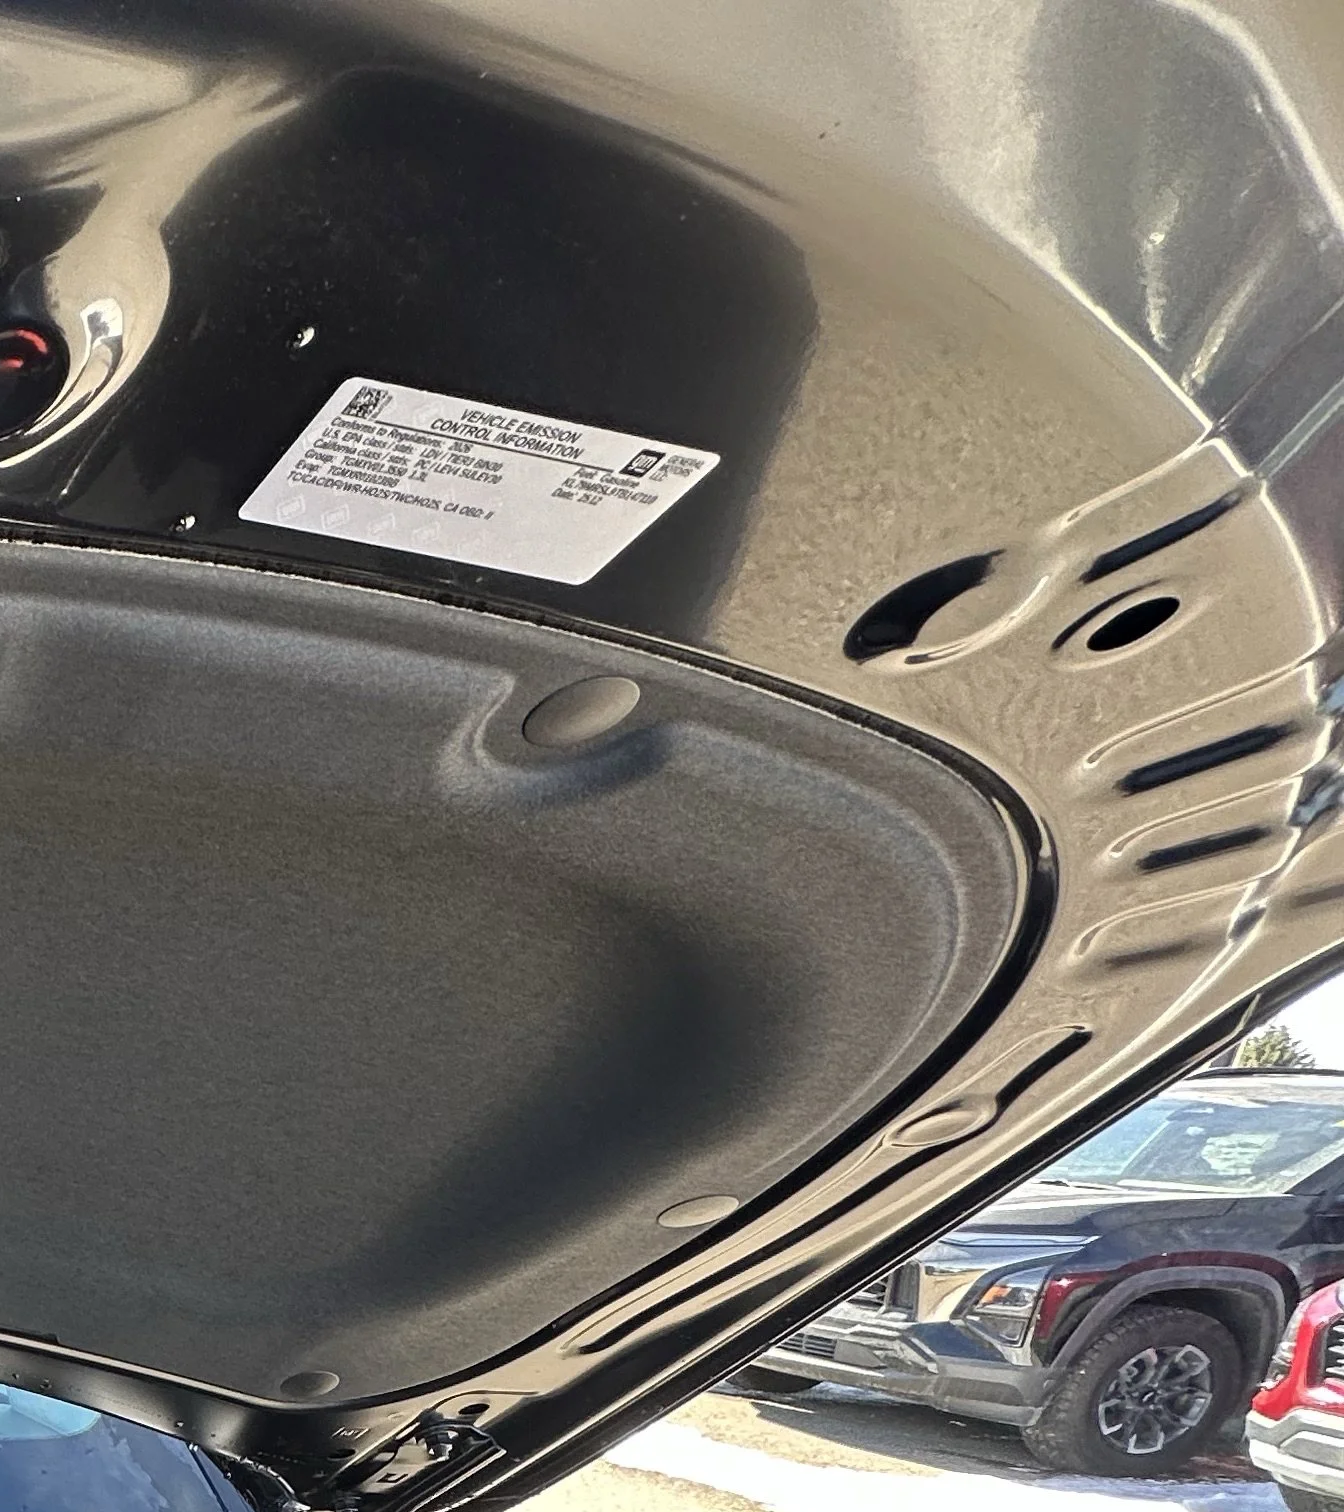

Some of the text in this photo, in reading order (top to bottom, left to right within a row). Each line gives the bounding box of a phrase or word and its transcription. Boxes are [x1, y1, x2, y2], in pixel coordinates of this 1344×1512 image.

[331, 417, 377, 433] Conforms
[430, 418, 584, 458] CONTROL INFORMATION
[459, 409, 582, 443] VEHICLE EMISSION
[313, 438, 358, 454] California
[357, 448, 382, 459] class
[415, 460, 430, 469] PC
[342, 432, 363, 443] EPA
[363, 437, 388, 448] class
[420, 449, 442, 459] LDV
[442, 503, 460, 512] CA
